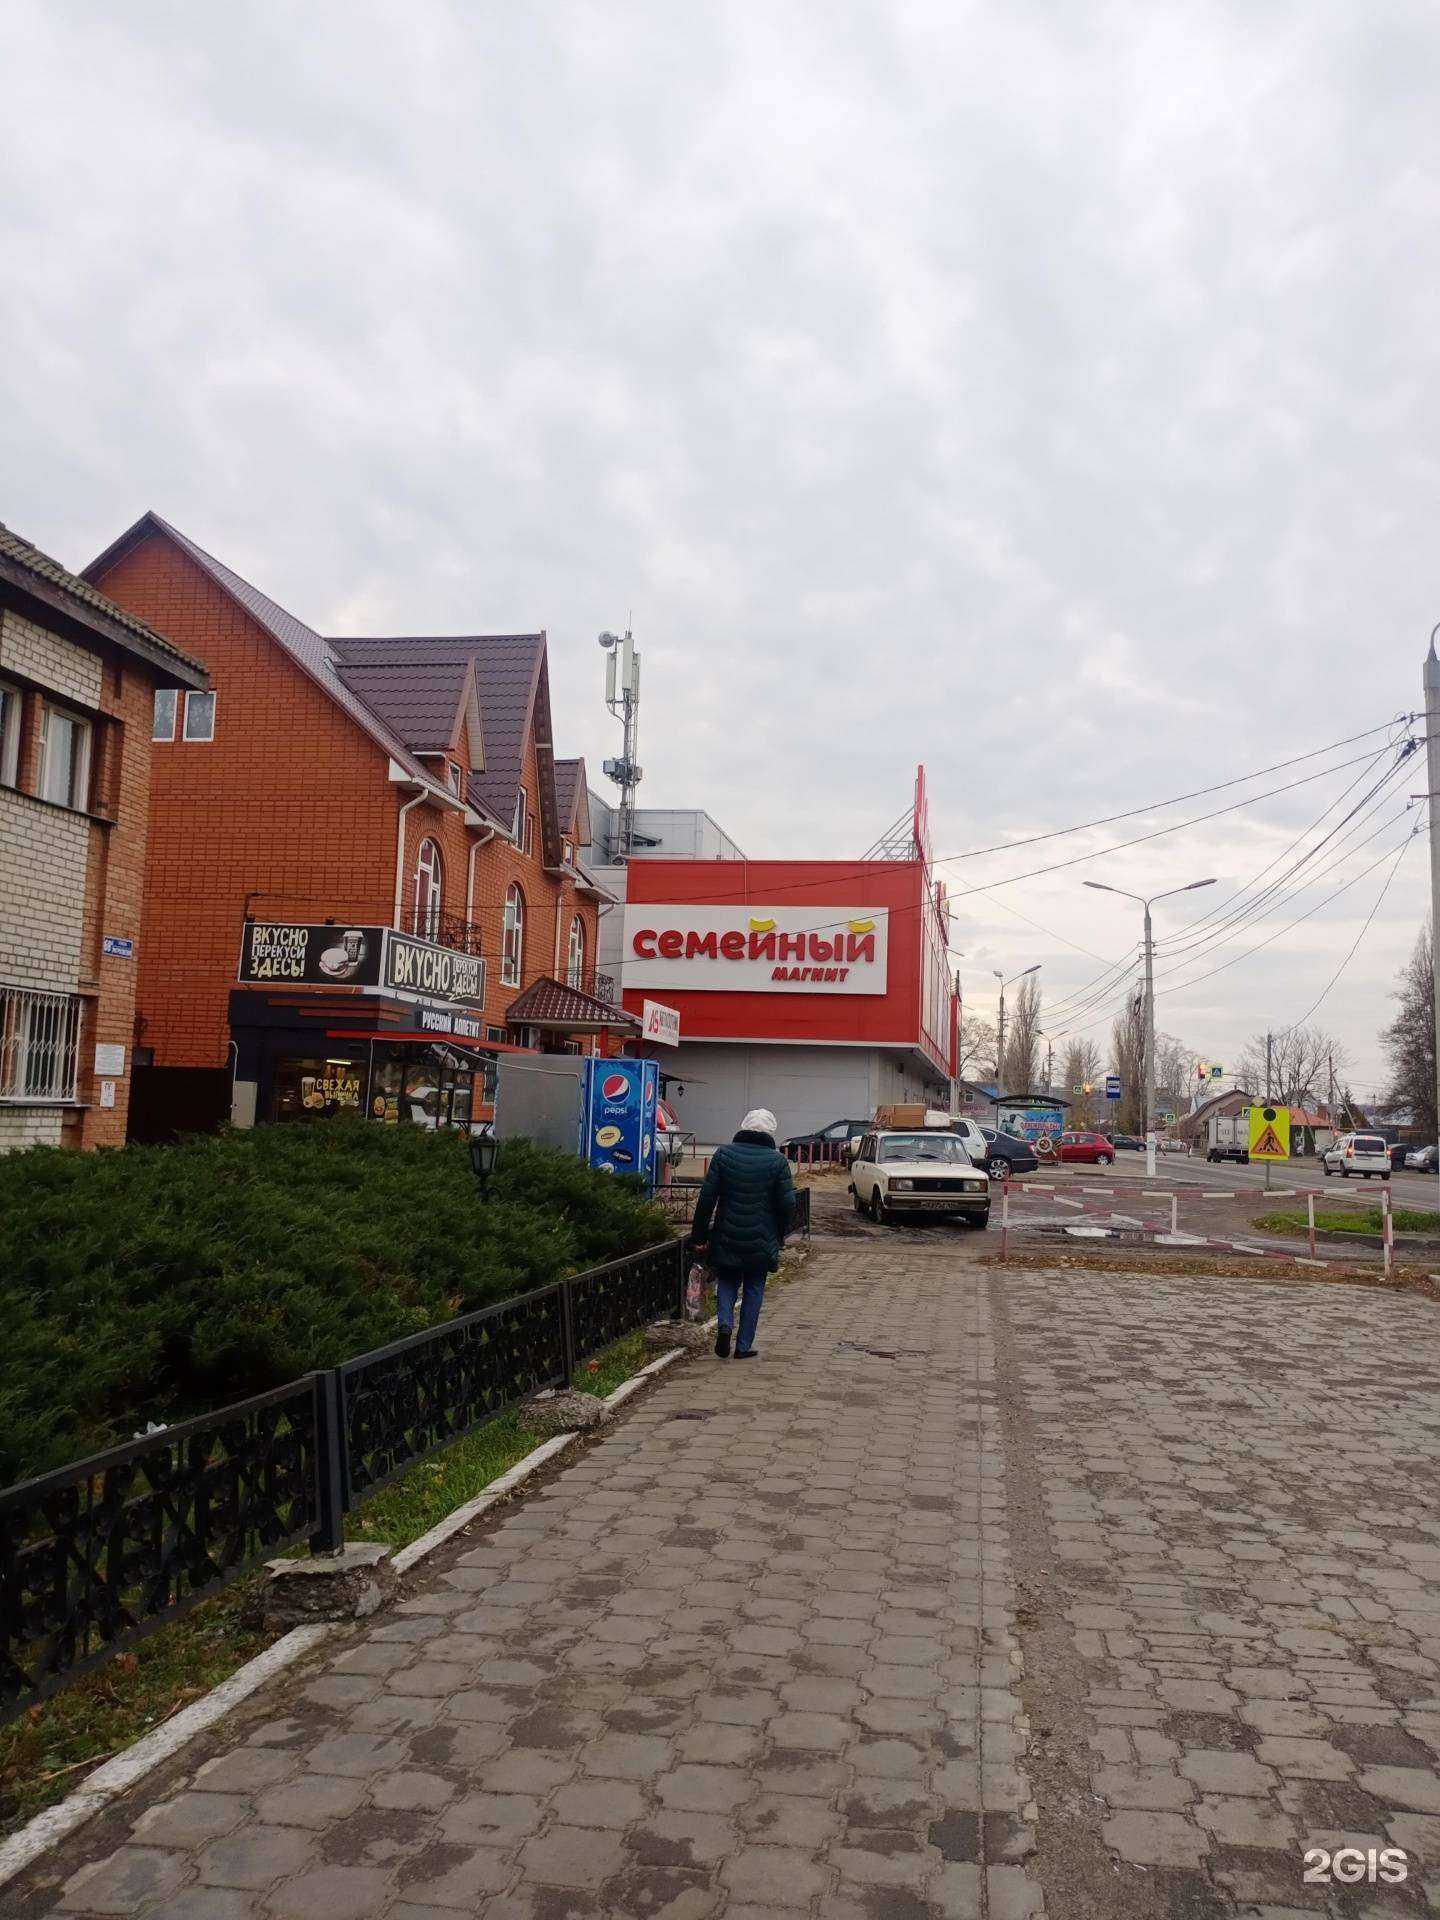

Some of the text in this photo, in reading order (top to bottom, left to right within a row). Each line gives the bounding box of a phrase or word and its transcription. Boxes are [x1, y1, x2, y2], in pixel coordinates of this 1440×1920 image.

[252, 927, 308, 947] ВКУСНО
[252, 944, 306, 960] ПЕРЕКУСИ
[250, 956, 305, 978] ЗДЕСЬ!
[395, 944, 450, 991] ВКУСНО
[771, 966, 850, 982] МАГНИТ
[422, 1011, 480, 1038] РУССКИЙ АППЕТИТ
[316, 1078, 360, 1092] СВЕЖАЯ
[604, 1106, 627, 1115] pepsi
